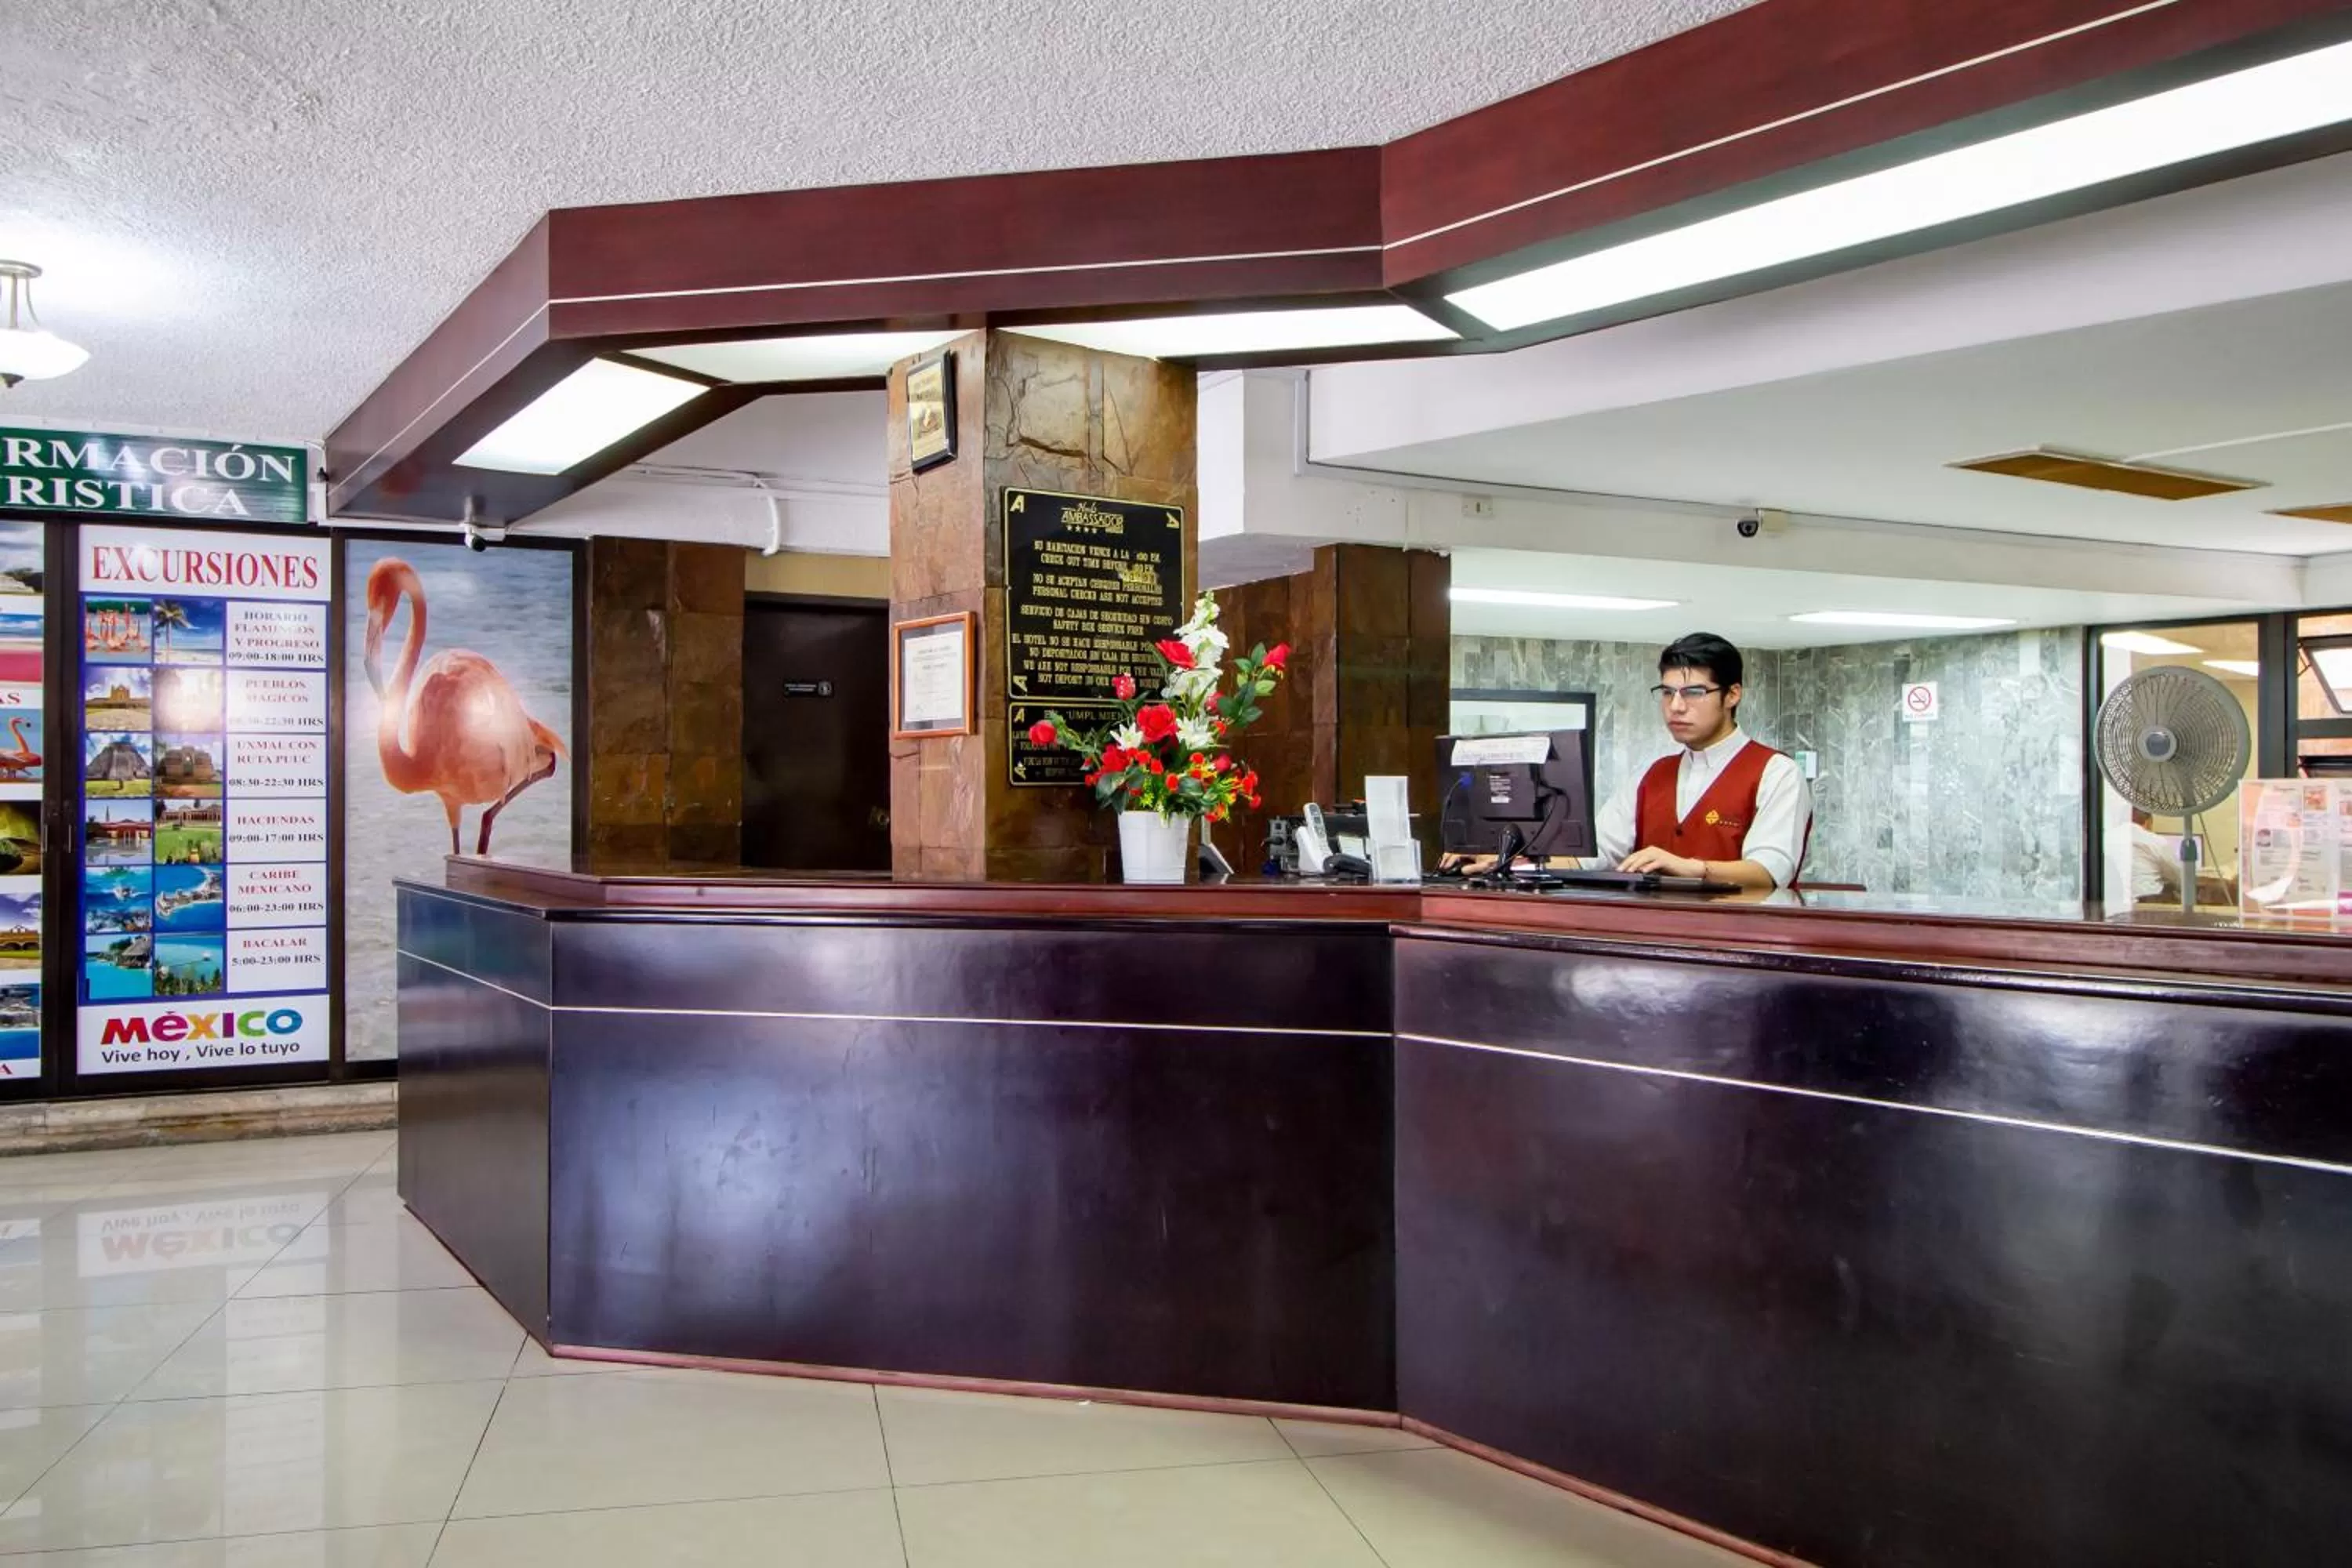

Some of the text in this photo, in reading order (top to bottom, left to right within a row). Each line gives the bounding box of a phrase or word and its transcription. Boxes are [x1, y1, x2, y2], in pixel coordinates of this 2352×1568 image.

[2, 437, 298, 484] RMACIÓN
[0, 474, 252, 516] RISTICA
[1062, 510, 1123, 528] AMBASSADOR
[92, 545, 318, 590] EXCURSIONES
[1033, 573, 1044, 584] NO
[244, 612, 308, 621] HORARIO
[1023, 634, 1046, 645] HOTEL
[299, 653, 323, 662] HRS
[245, 680, 307, 688] PUEBLOS
[299, 717, 323, 726] HRS
[238, 741, 317, 750] UXMAL CON
[238, 755, 311, 764] RUTA PUUC
[229, 778, 294, 786] 08:30-22:30
[238, 816, 314, 825] HACIENDAS
[229, 833, 294, 843] 09:00-17:00
[249, 870, 299, 879] CARIBE
[238, 884, 312, 894] MEXICANO
[229, 903, 294, 913] 06:00-23:00
[243, 938, 307, 948] BACALAR
[232, 955, 320, 965] 5:00-23:00 HRS
[101, 1050, 140, 1063] Vive
[196, 1044, 234, 1058] Vive
[240, 1043, 256, 1055] lo
[261, 1042, 299, 1056] tuyo
